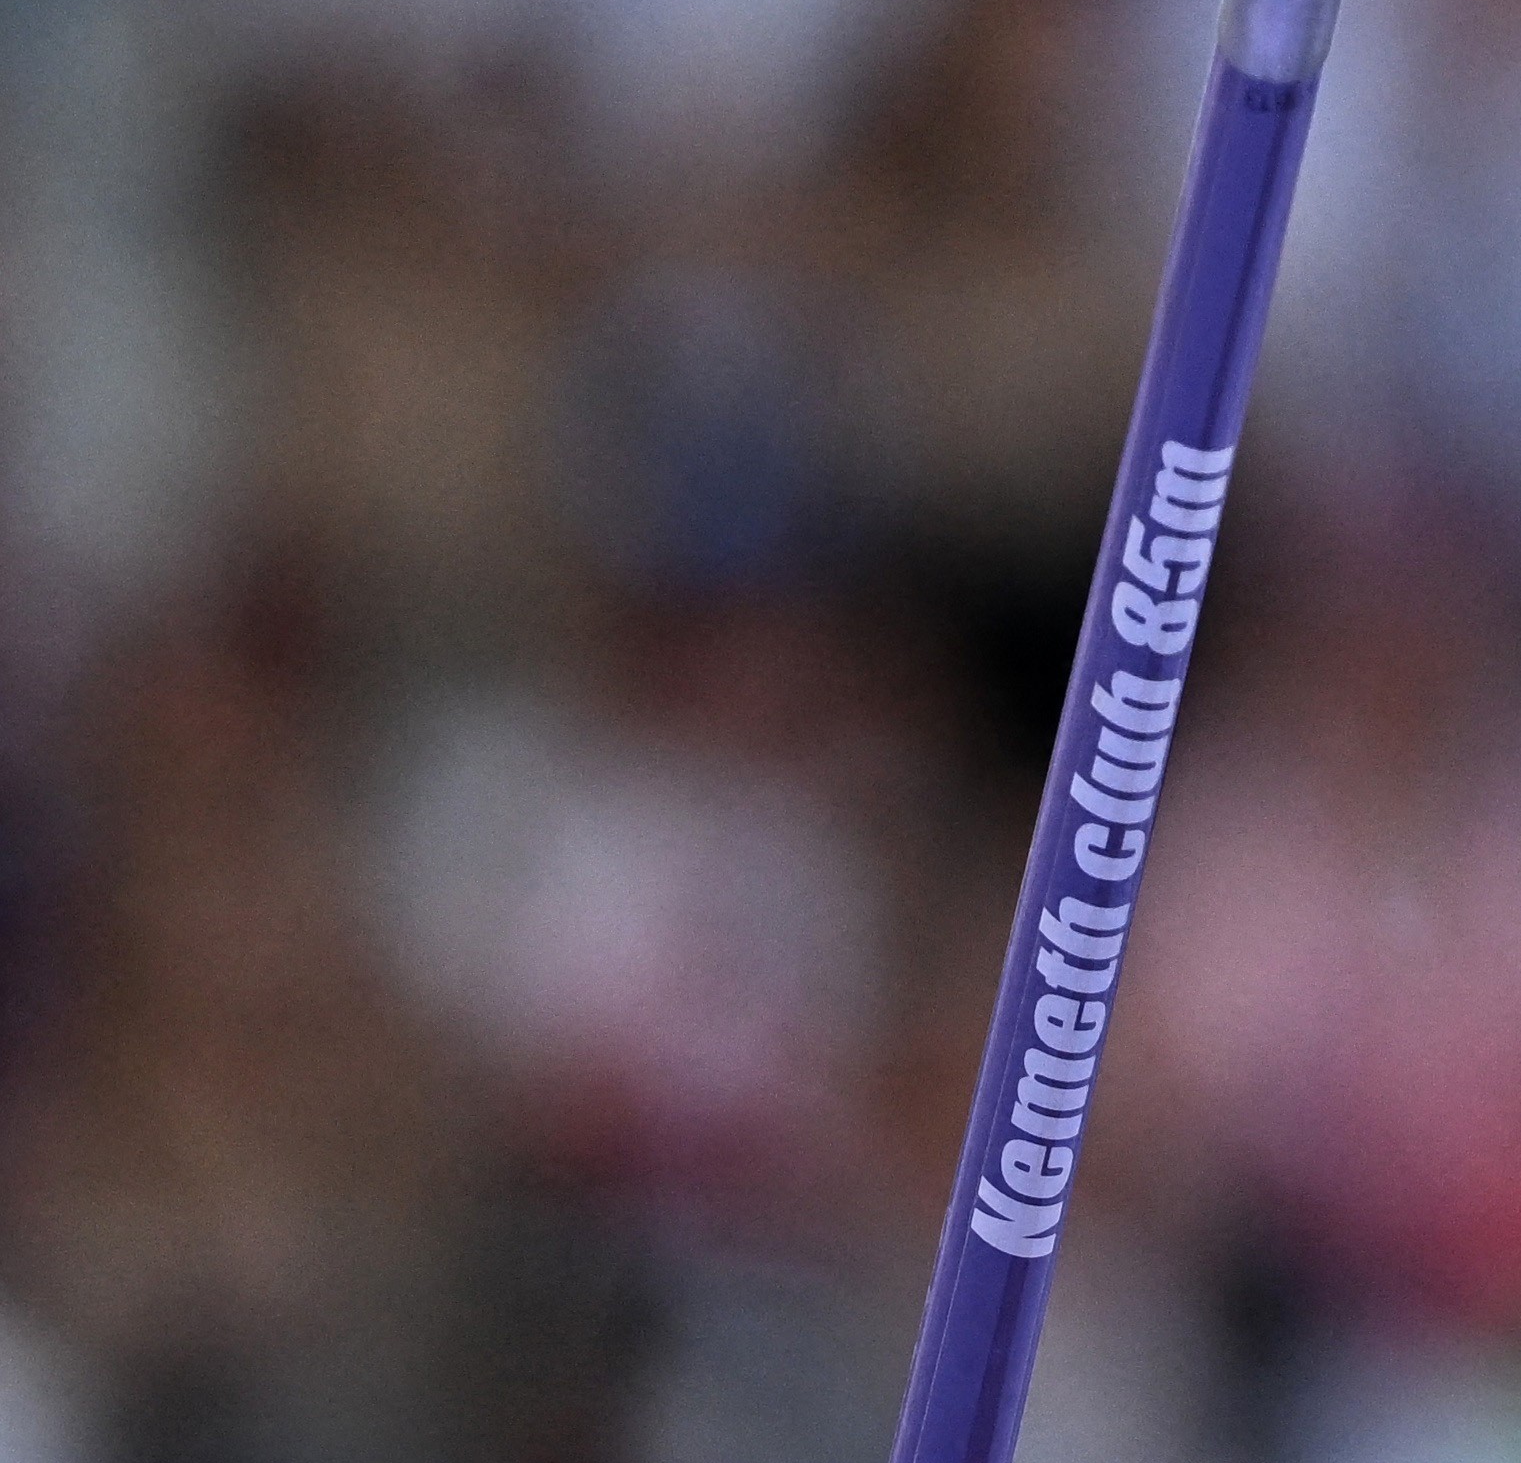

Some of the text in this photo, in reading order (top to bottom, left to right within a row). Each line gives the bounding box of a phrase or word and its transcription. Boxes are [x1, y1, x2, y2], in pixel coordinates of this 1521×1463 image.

[970, 437, 1235, 1259] Nemeth club 85m
